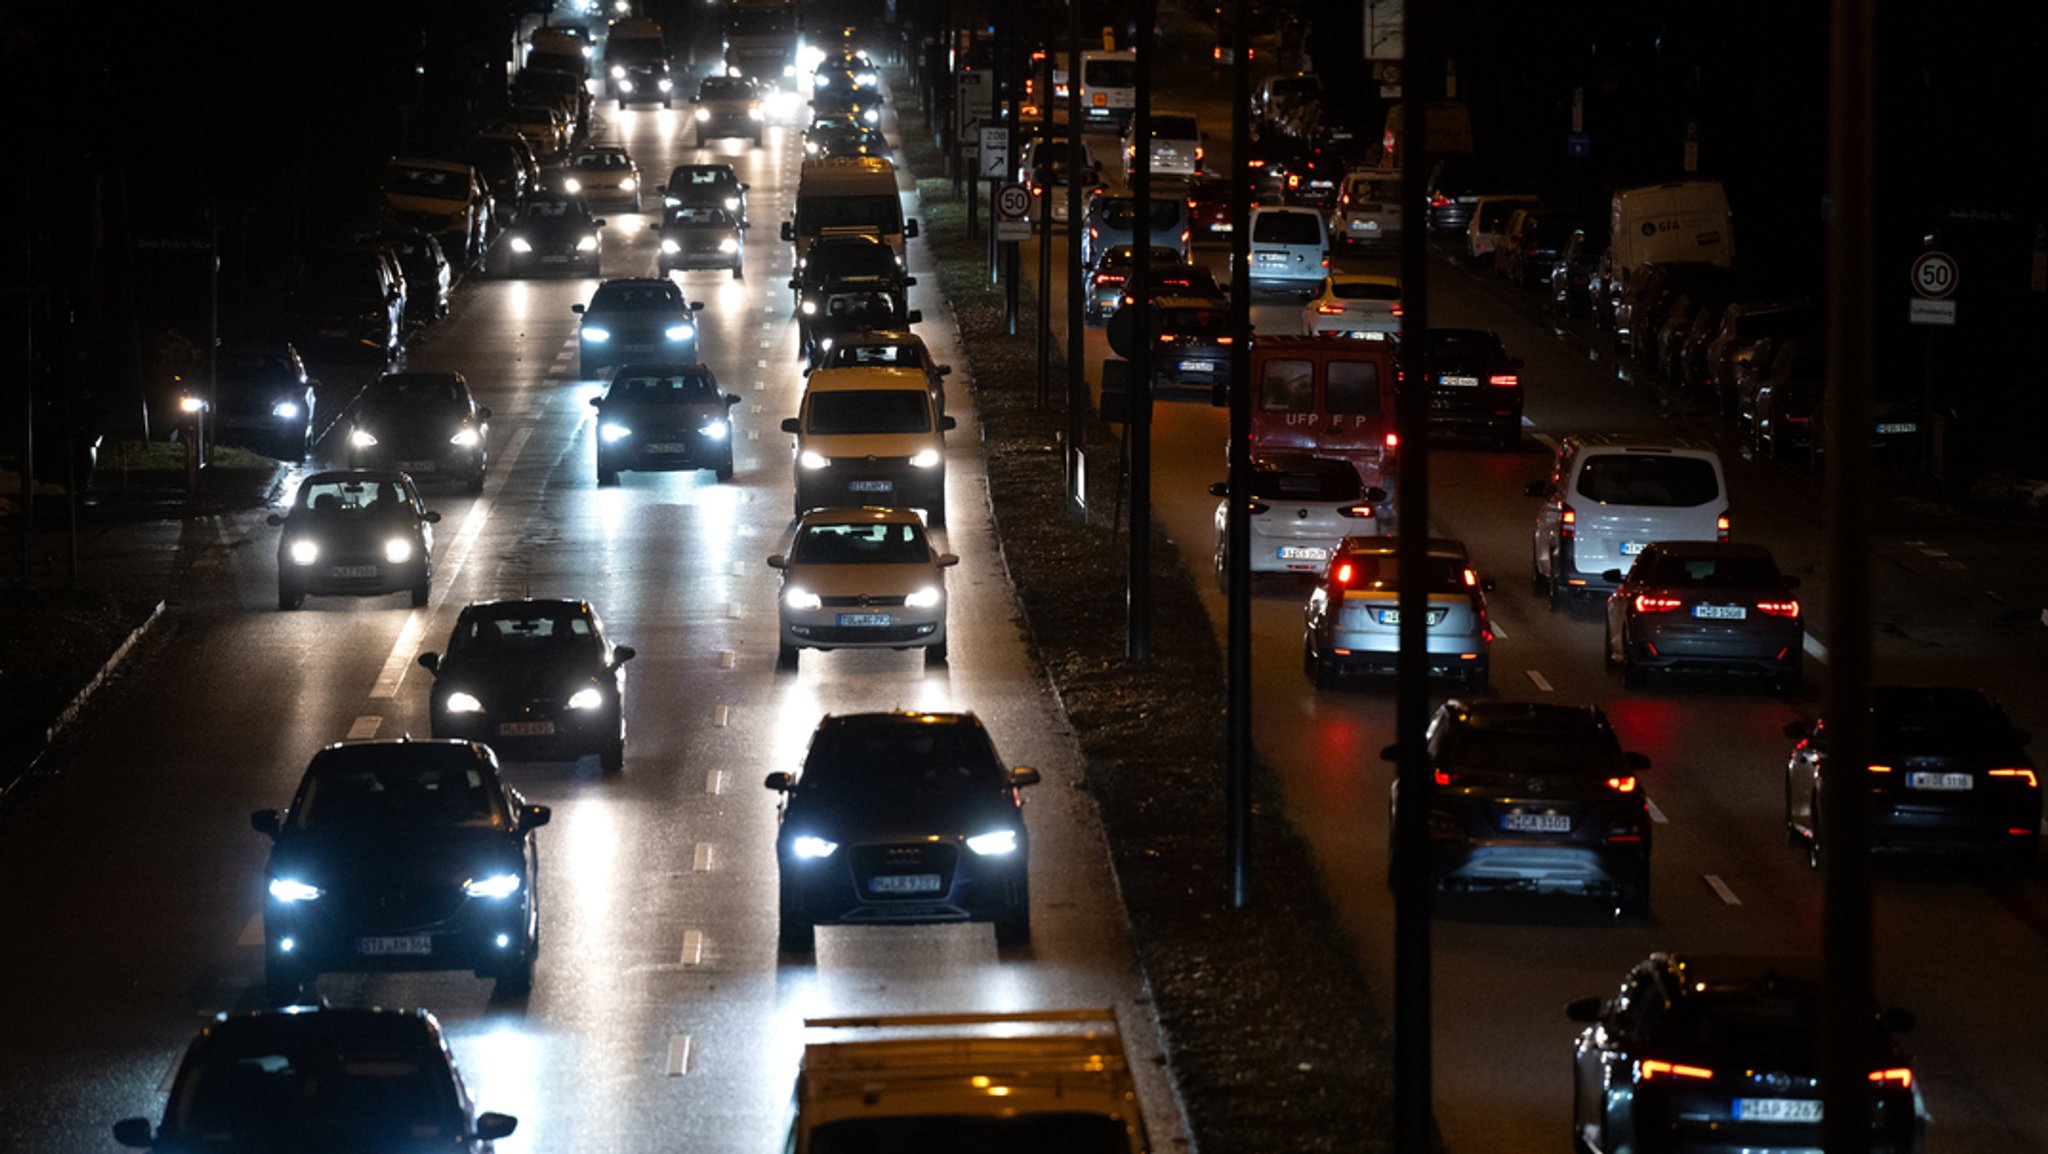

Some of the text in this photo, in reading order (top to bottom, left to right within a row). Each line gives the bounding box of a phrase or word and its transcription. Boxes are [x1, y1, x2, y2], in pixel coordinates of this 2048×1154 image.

[1005, 193, 1025, 209] 50
[1658, 220, 1680, 232] GFA
[1923, 265, 1948, 285] 50
[1286, 412, 1320, 426] UFP
